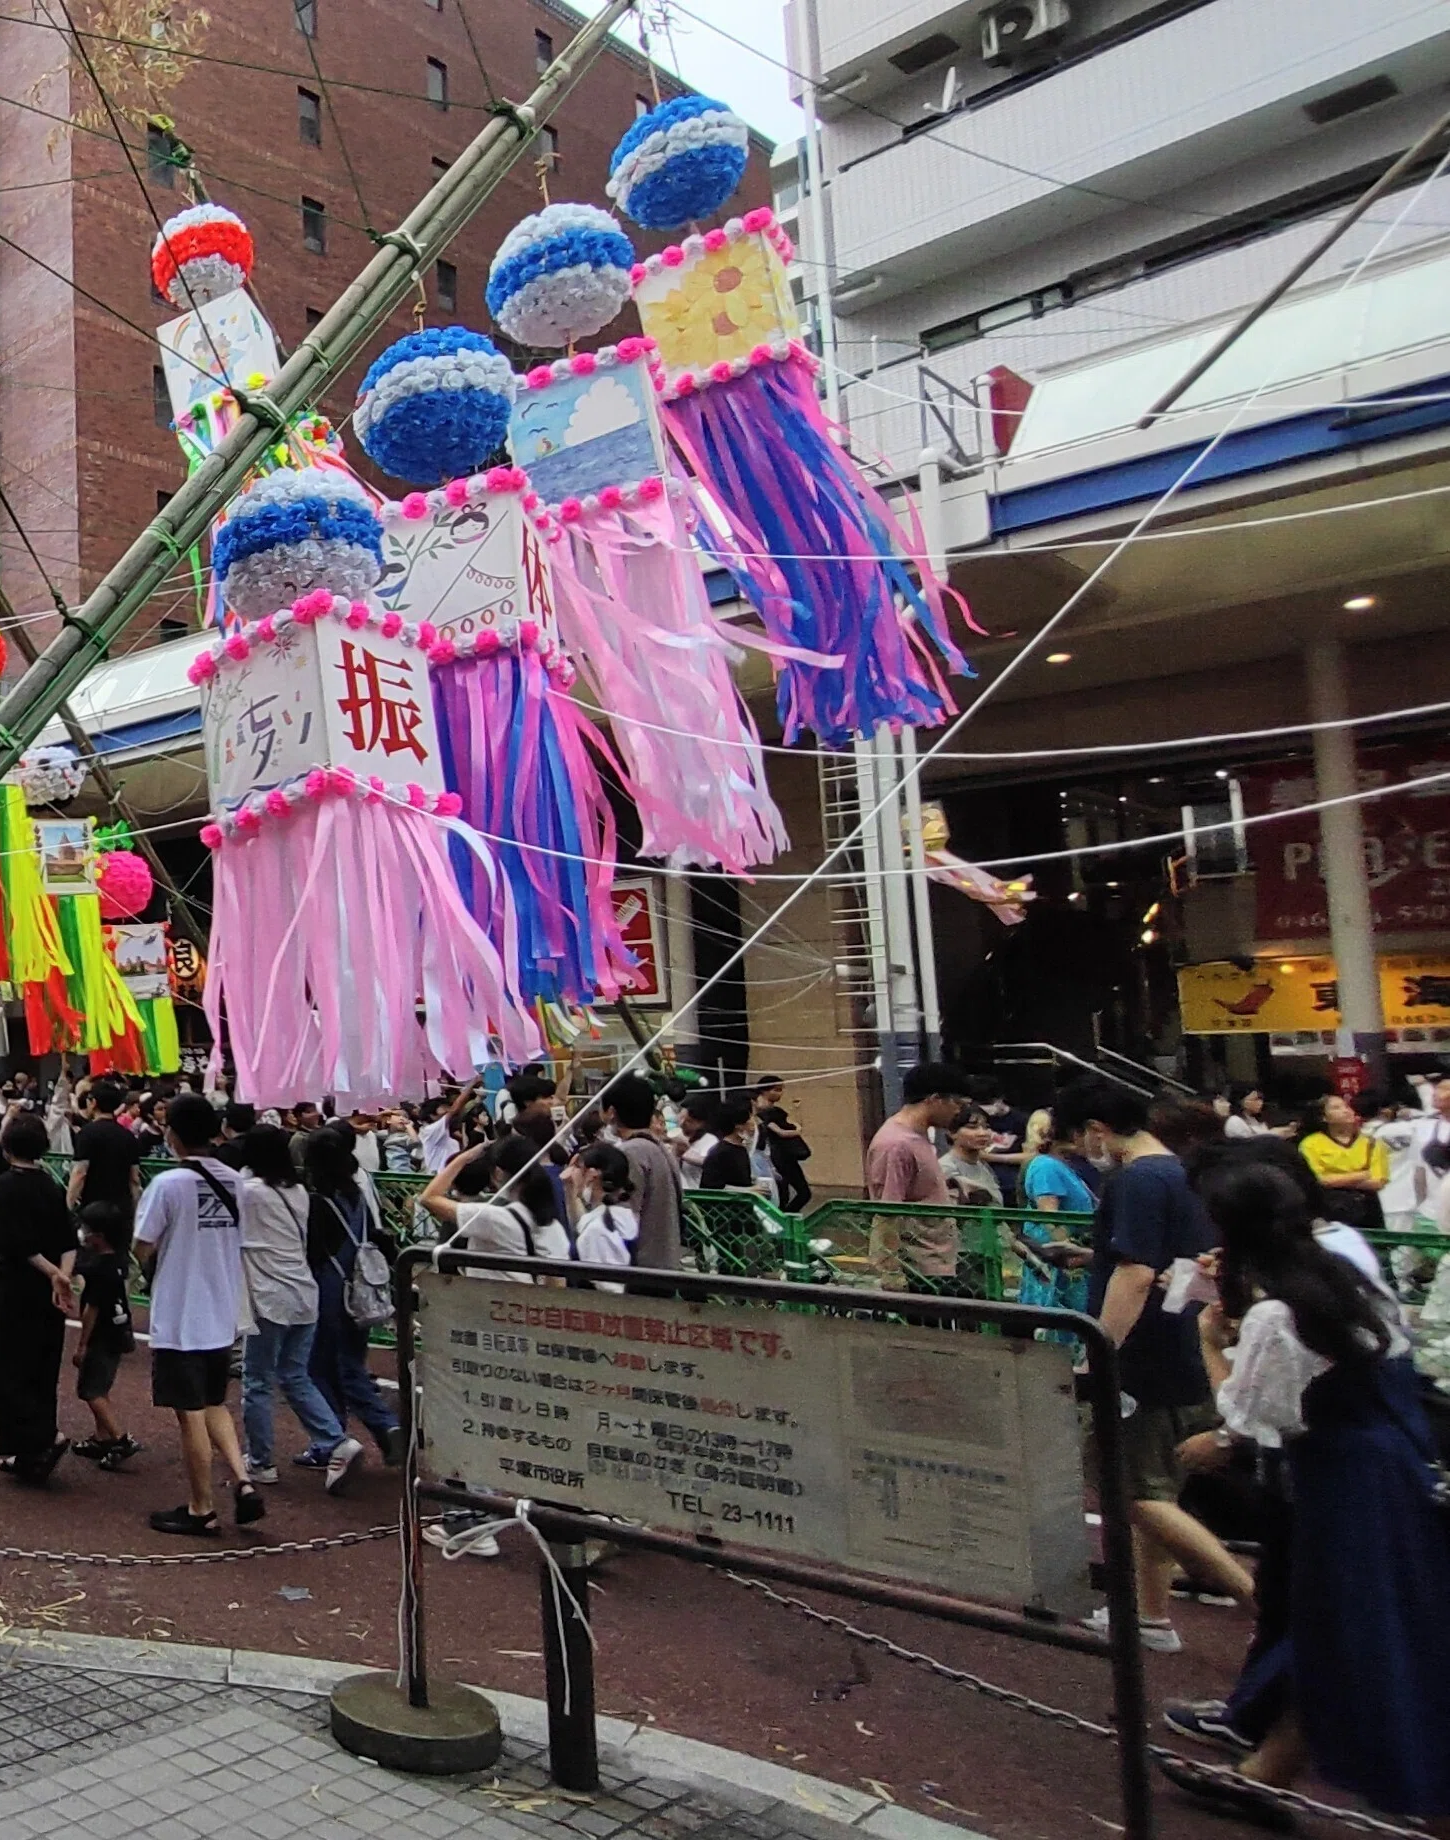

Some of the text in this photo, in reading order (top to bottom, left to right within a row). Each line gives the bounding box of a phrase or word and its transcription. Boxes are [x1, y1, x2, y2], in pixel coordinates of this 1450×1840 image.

[334, 639, 429, 765] 振
[499, 1457, 585, 1489] 平塚市役所
[666, 1490, 794, 1533] TEL 23-1111
